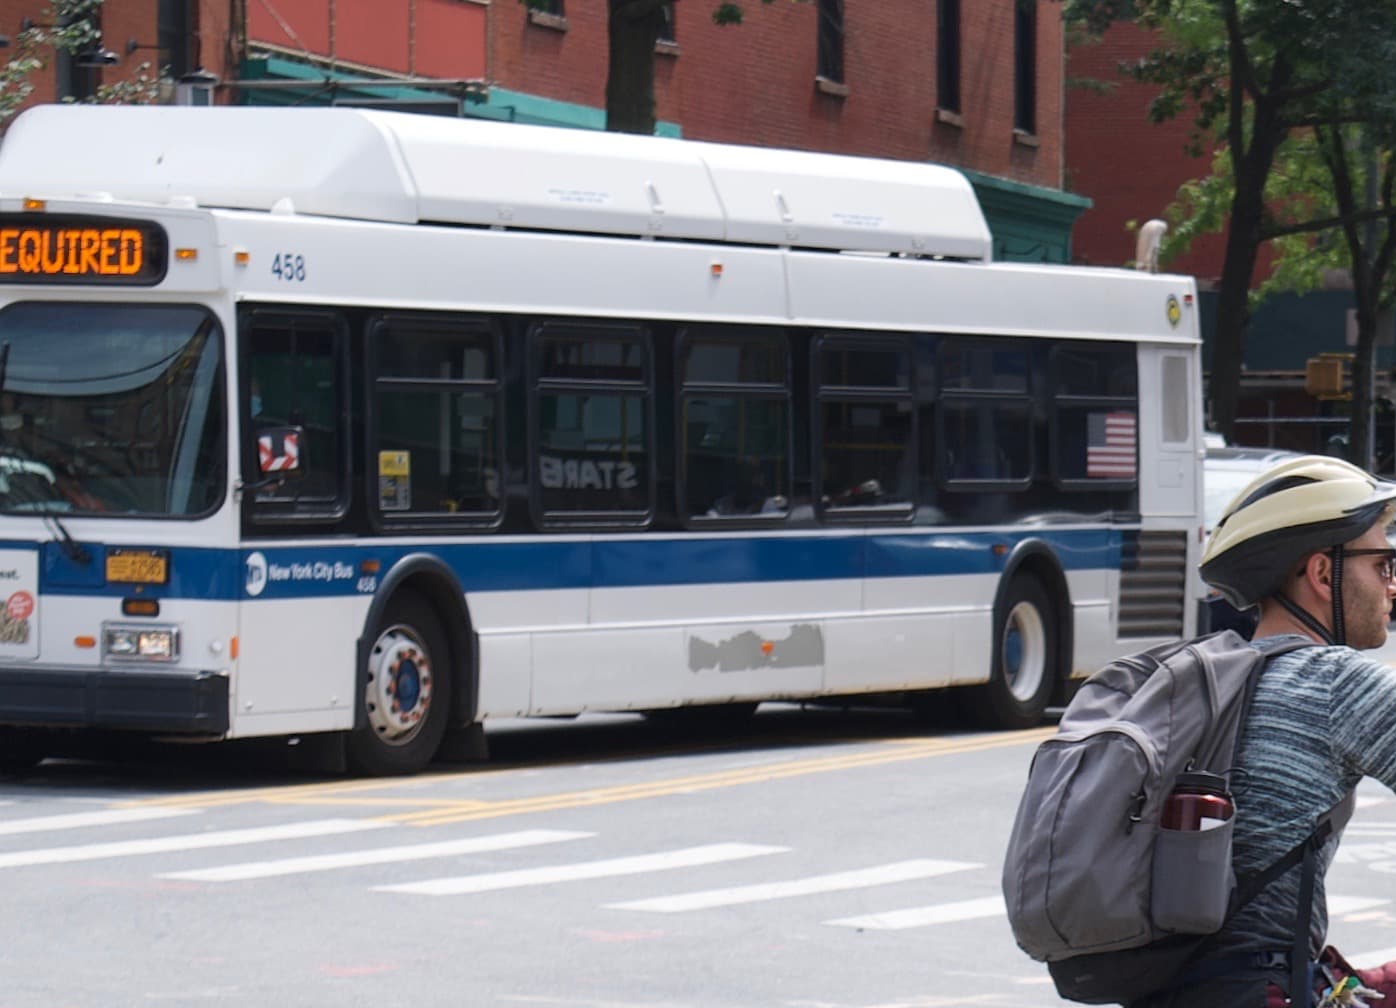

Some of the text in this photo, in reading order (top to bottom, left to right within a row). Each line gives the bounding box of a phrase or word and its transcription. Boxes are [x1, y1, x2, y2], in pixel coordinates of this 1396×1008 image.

[271, 254, 306, 281] 458
[269, 564, 291, 581] New
[291, 562, 313, 580] York
[313, 561, 334, 582] City
[334, 561, 355, 579] Bus
